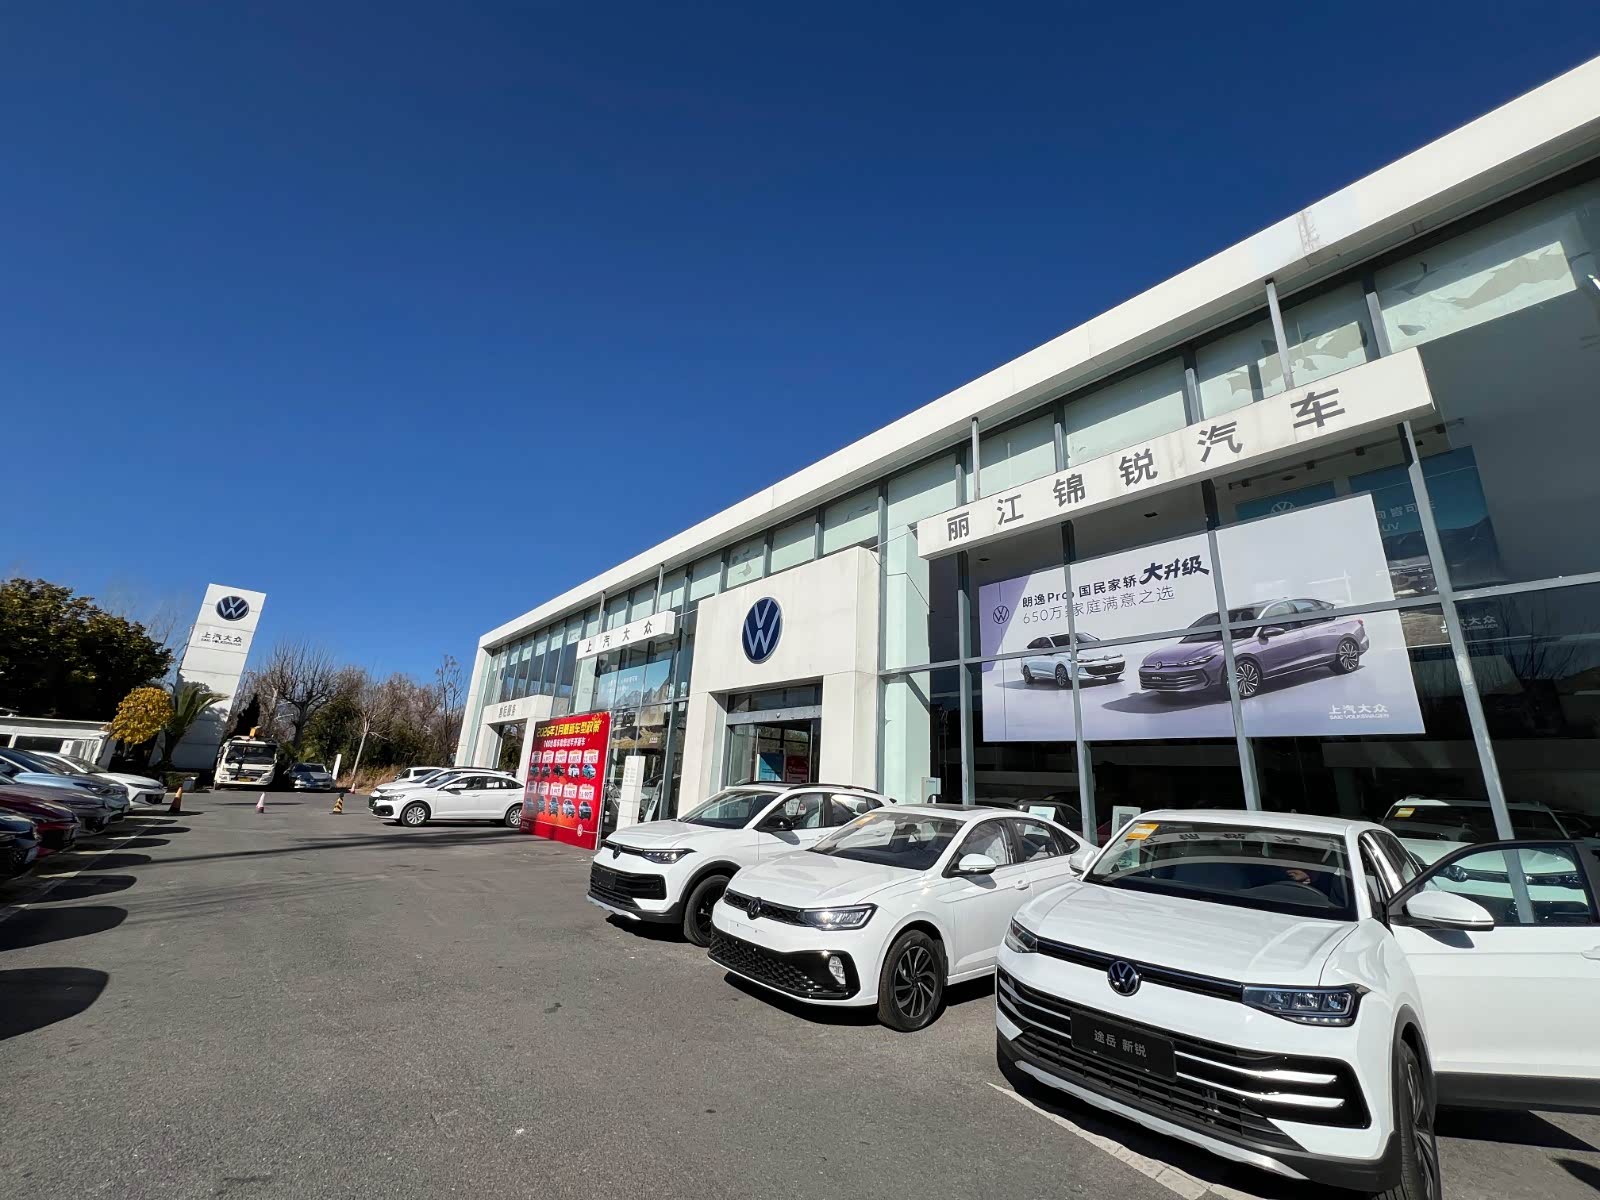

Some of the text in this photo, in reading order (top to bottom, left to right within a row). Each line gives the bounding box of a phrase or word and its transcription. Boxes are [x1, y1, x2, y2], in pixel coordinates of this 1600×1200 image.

[947, 388, 1346, 542] 丽江锦锐汽车
[1079, 575, 1137, 598] 国民家轿
[1140, 554, 1210, 585] 大升级
[1023, 586, 1175, 624] 650万家庭满意之选
[201, 631, 242, 643] 上汽大众
[585, 620, 652, 653] 上汽大众
[1329, 703, 1389, 714] 上汽大众
[1094, 1029, 1147, 1058] 途岳 新锐
